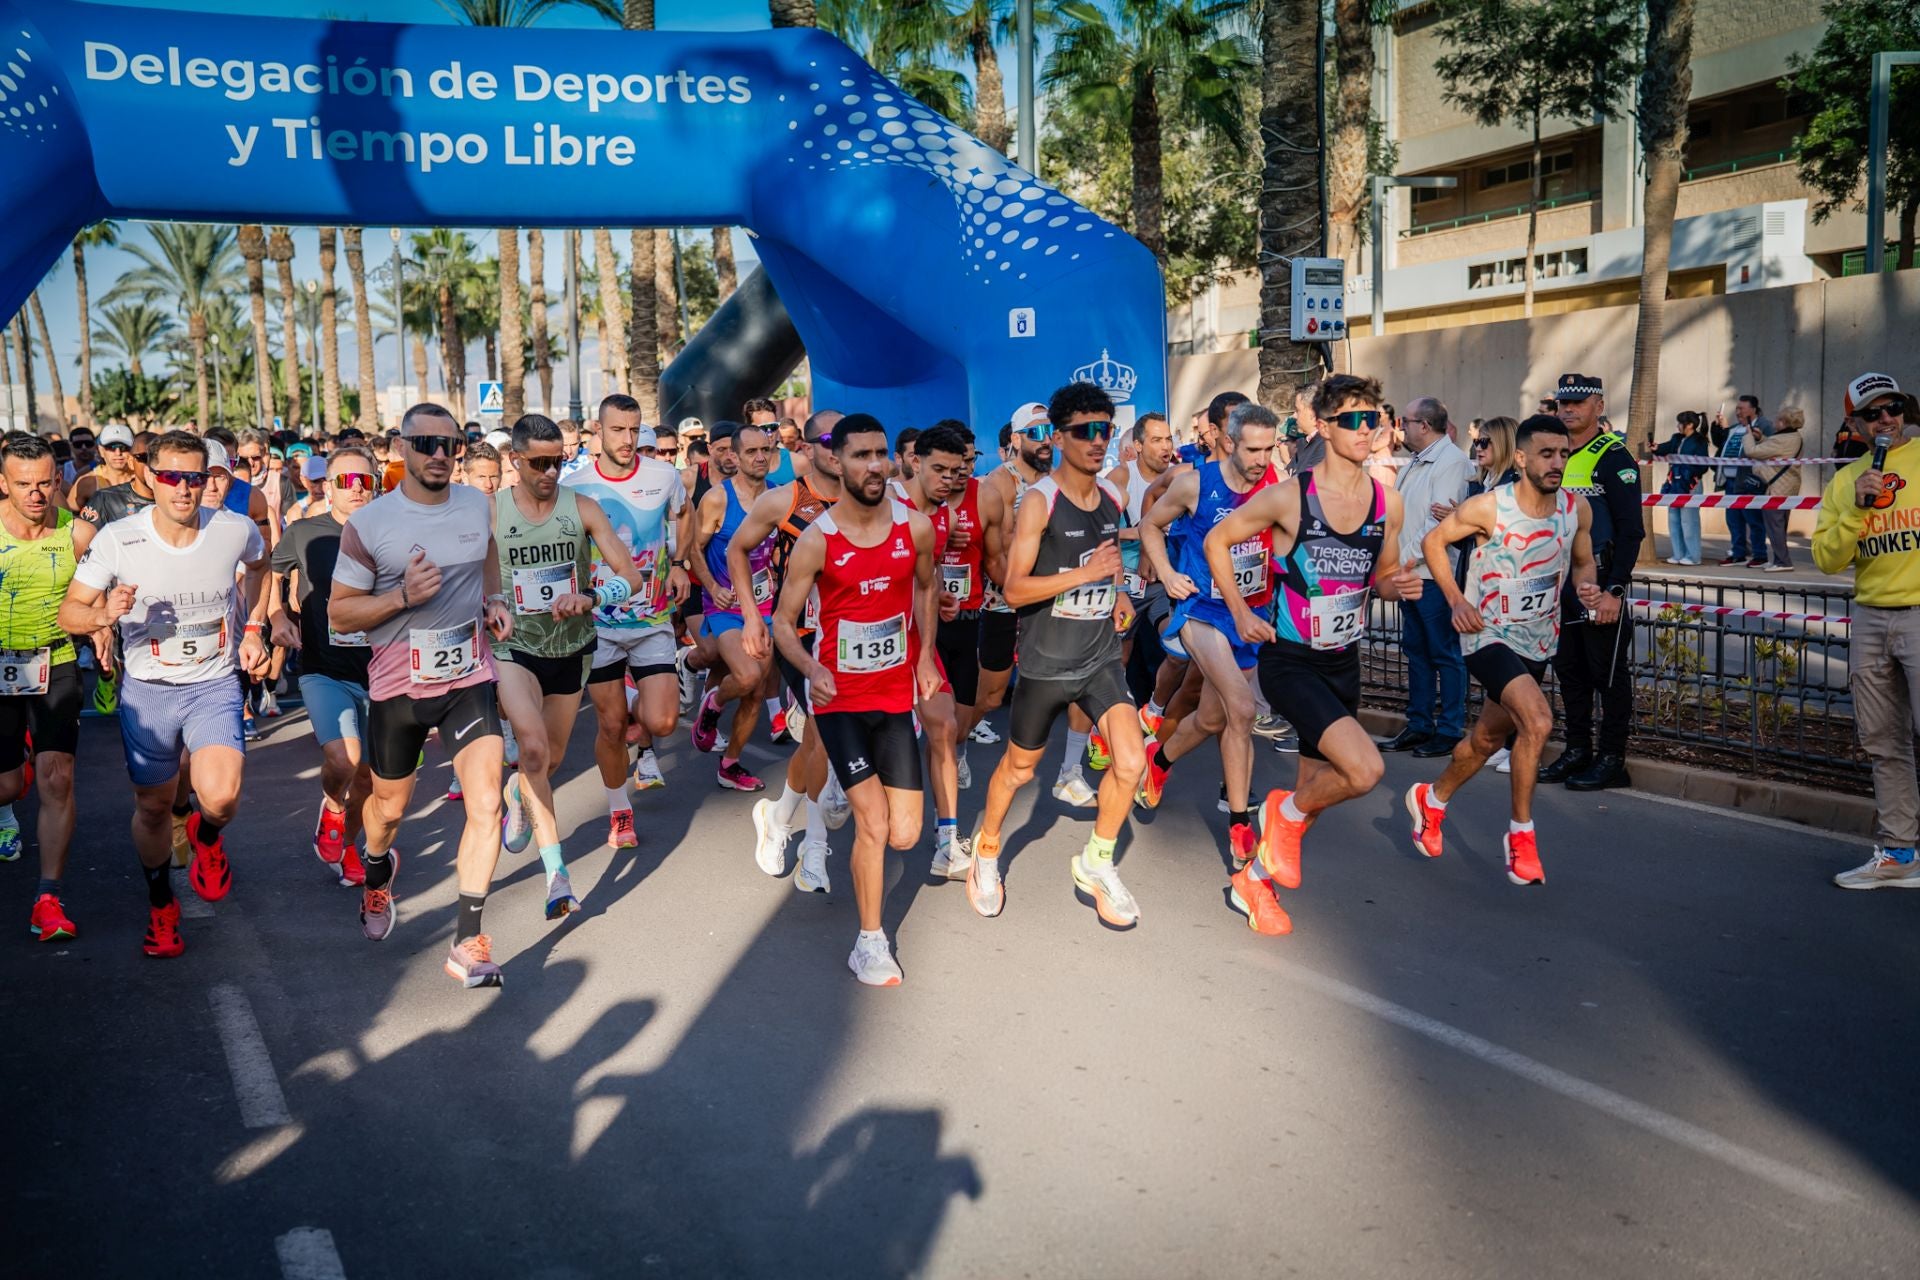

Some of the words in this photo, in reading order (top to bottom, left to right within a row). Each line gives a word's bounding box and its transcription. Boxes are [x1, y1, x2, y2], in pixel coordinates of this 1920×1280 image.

[84, 40, 415, 101] Delegación
[428, 60, 499, 100] de
[512, 64, 752, 113] Deportes
[225, 123, 260, 167] y
[272, 116, 489, 173] Tiempo
[503, 122, 637, 167] Libre
[1859, 507, 1920, 538] YCLING
[508, 541, 576, 566] PEDRITO
[1857, 530, 1920, 558] MONKEY
[540, 585, 554, 601] 9
[1069, 587, 1108, 606] 117
[1520, 592, 1547, 612] 27
[1332, 612, 1356, 634] 22
[182, 640, 198, 656] 5
[434, 647, 463, 669] 23
[852, 638, 895, 660] 138
[3, 665, 18, 682] 8
